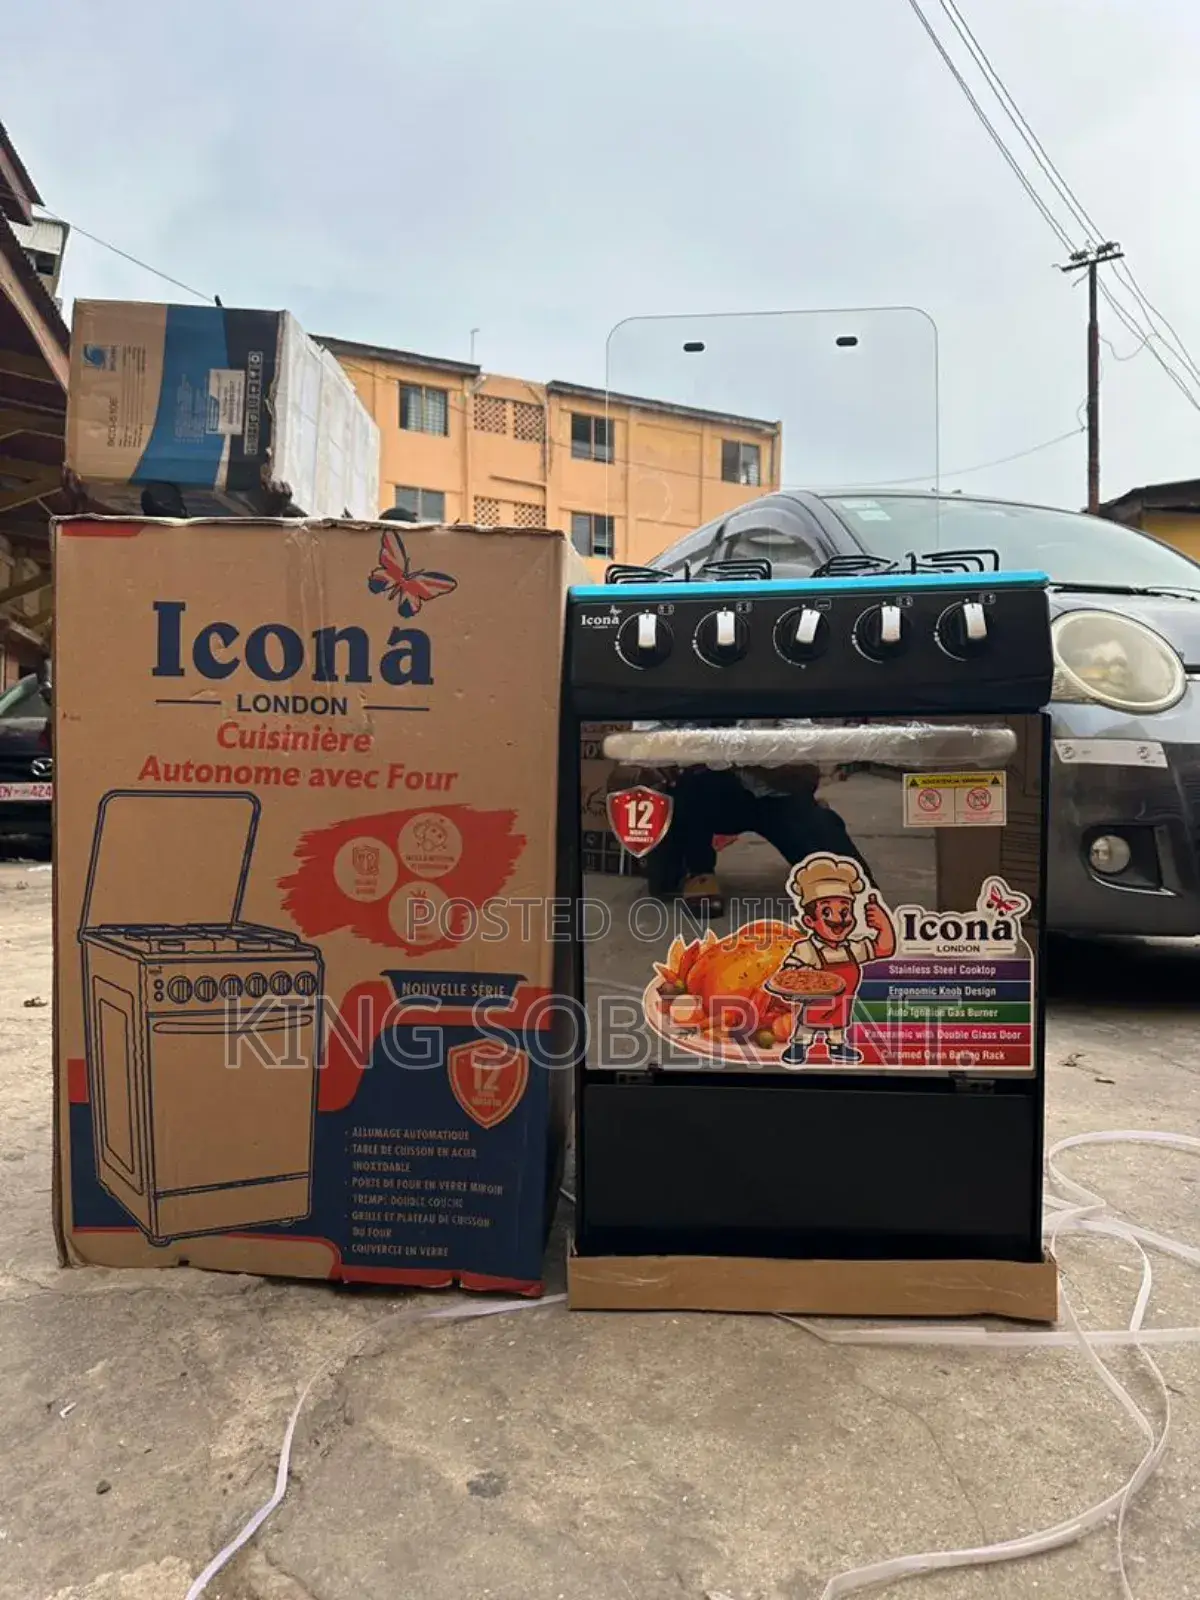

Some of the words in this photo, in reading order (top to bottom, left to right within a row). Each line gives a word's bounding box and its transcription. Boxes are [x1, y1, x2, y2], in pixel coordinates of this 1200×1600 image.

[580, 614, 619, 625] Icona
[151, 600, 434, 686] Icona
[237, 694, 347, 715] LONDON
[217, 722, 371, 752] Cuisinière
[138, 756, 300, 786] Autonome
[309, 767, 378, 790] avec
[387, 764, 458, 791] Four
[624, 800, 654, 829] 12
[903, 913, 1013, 941] Icona
[936, 945, 980, 953] LONDON
[889, 964, 930, 975] Stainless
[934, 964, 956, 975] Steel
[959, 965, 996, 977] Cooktop
[401, 982, 466, 996] NOUVELLE
[472, 980, 505, 998] SÉRIE
[888, 986, 936, 997] Ergonomic
[939, 986, 962, 996] Knob
[965, 986, 997, 998] Design
[947, 1007, 965, 1017] Gas
[967, 1007, 998, 1017] Burner
[937, 1030, 968, 1040] Double
[971, 1030, 997, 1040] Glass
[1000, 1030, 1022, 1040] Door
[983, 1051, 1005, 1060] Rack
